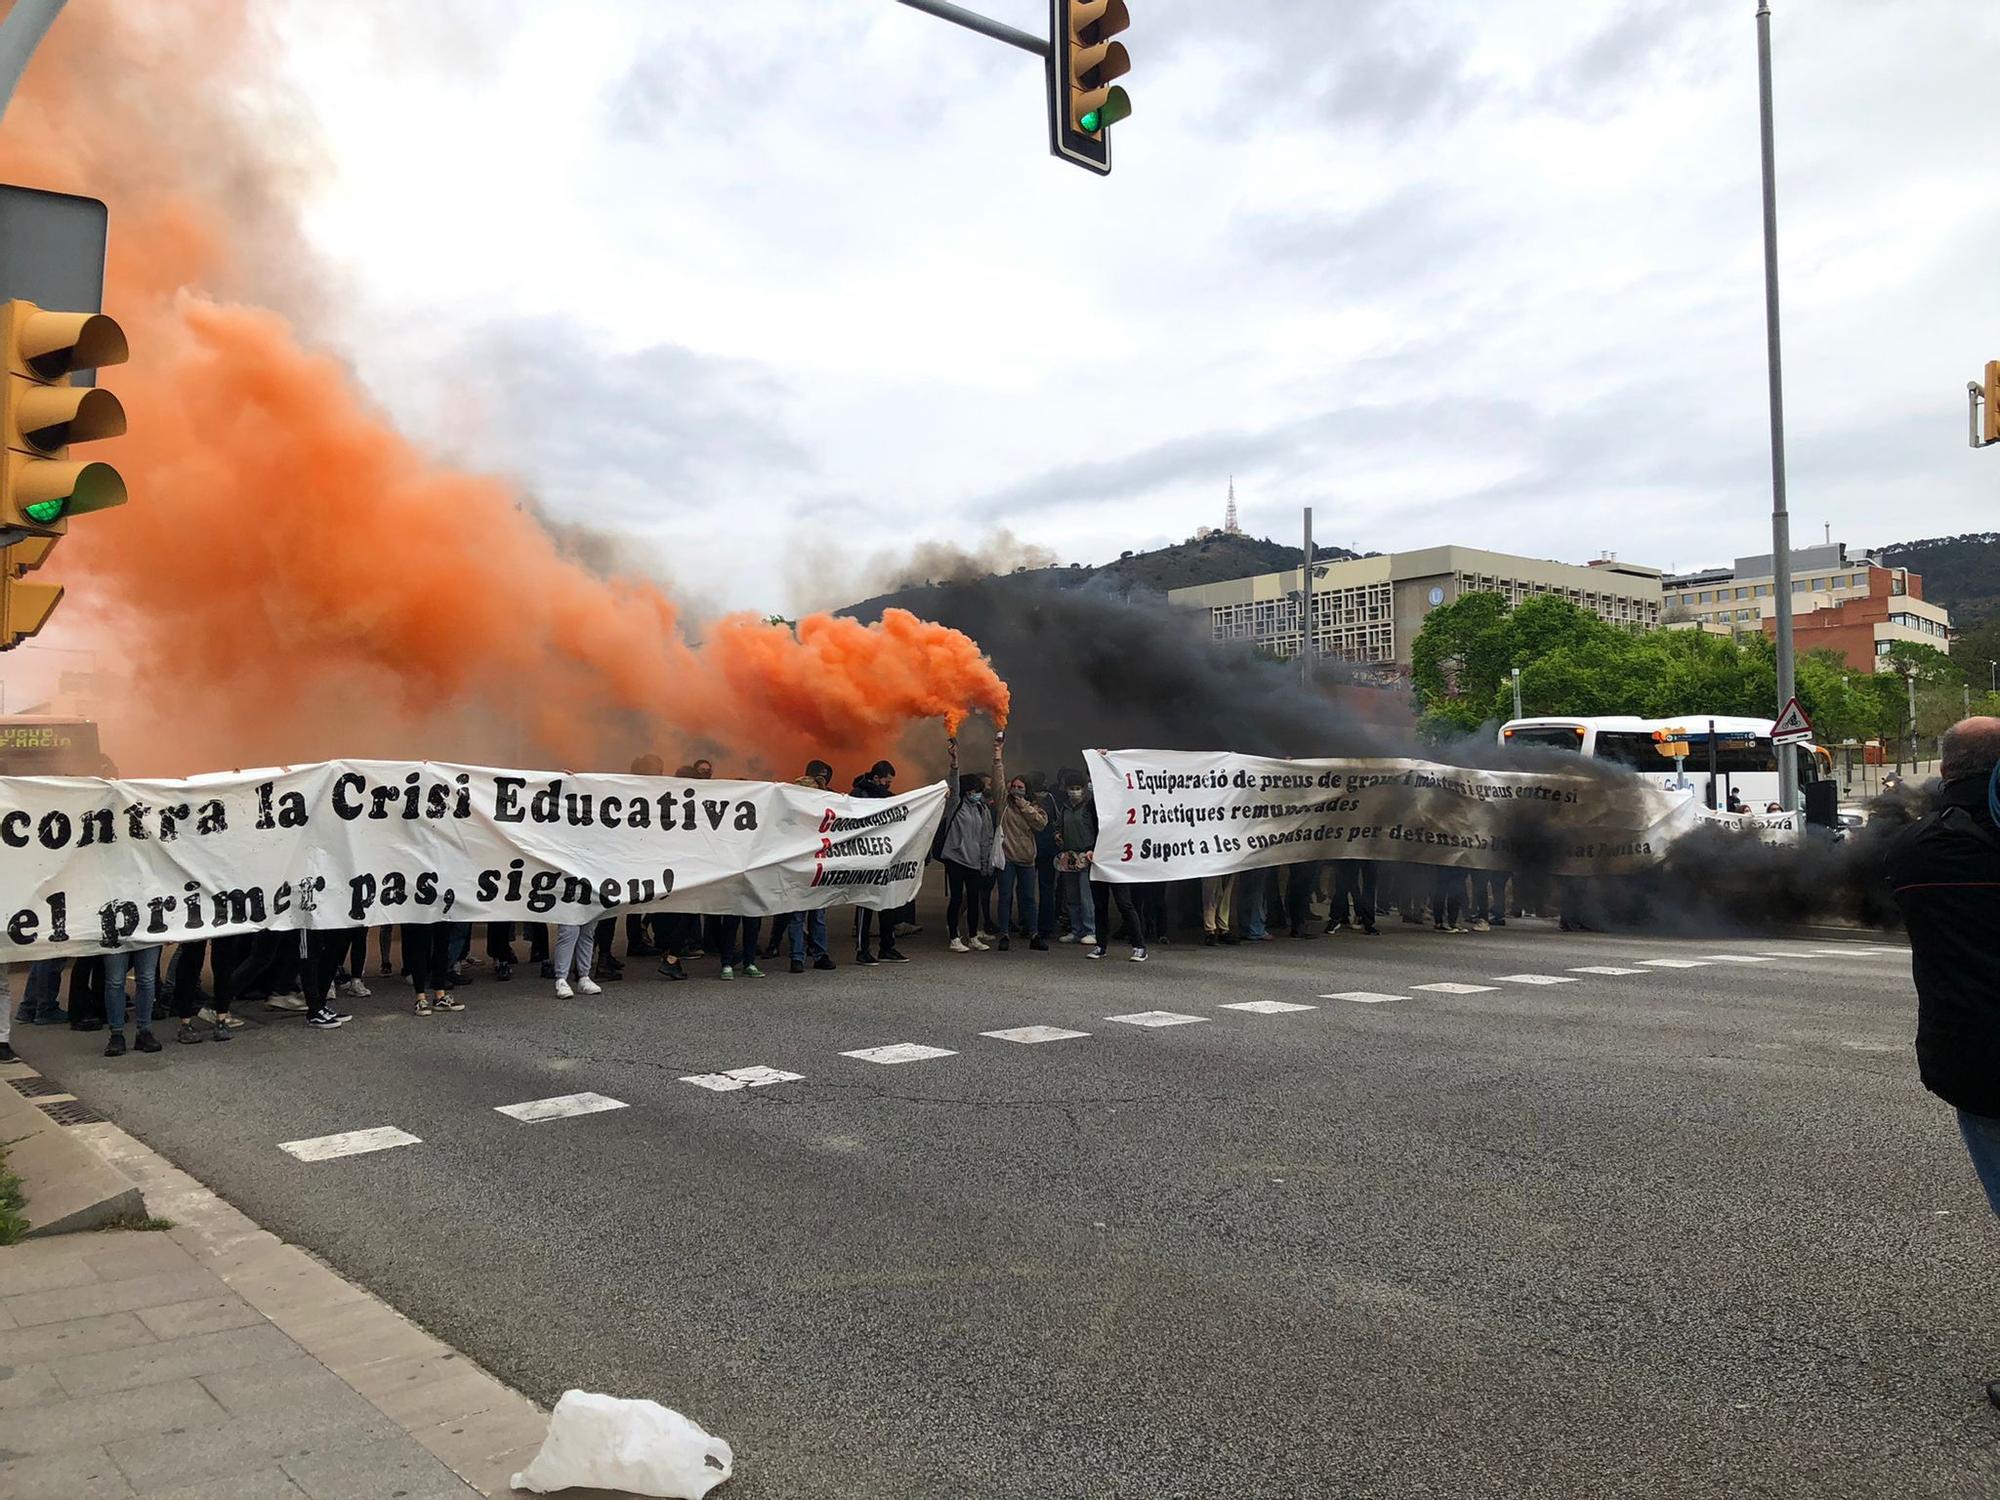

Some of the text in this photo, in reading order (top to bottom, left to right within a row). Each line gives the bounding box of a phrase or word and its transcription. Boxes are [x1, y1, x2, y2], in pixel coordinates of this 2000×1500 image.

[1125, 772, 1135, 790] 1
[1135, 769, 1229, 795] Equiparació
[1232, 769, 1257, 789] de
[1259, 773, 1314, 792] preus
[1317, 770, 1342, 789] de
[1467, 779, 1474, 797] i
[1475, 783, 1513, 801] graus
[1515, 784, 1562, 802] entre
[1563, 788, 1579, 804] si
[1, 772, 759, 850] contra la Crisi Educativa
[1126, 808, 1137, 825] 2
[1142, 803, 1226, 827] Pràctiques
[1120, 842, 1134, 862] 3
[1140, 838, 1195, 862] Suport
[1200, 840, 1210, 855] a
[1213, 834, 1241, 854] les
[1347, 824, 1382, 843] per
[1388, 824, 1473, 849] defensar
[7, 858, 676, 949] el primer pas, signeu!
